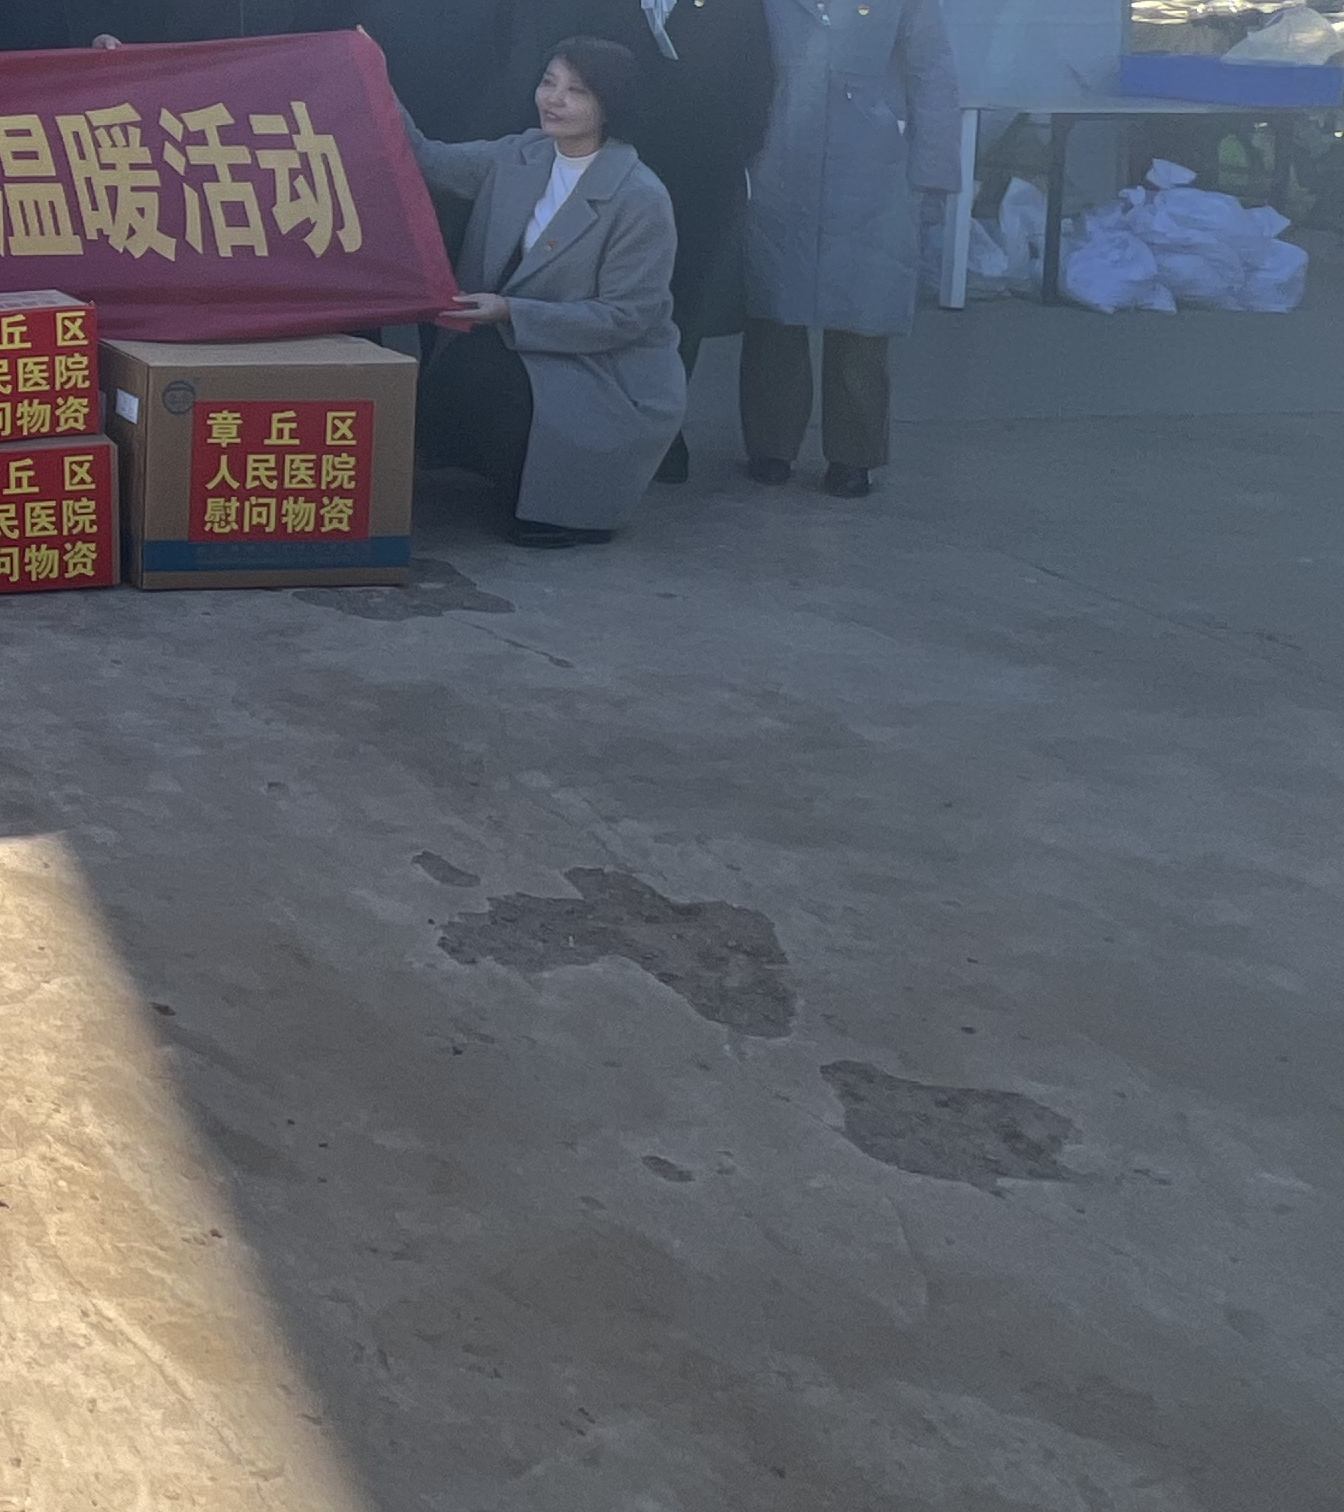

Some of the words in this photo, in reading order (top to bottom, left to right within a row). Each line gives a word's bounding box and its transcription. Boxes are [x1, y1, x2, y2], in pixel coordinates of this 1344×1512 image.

[206, 409, 358, 447] 章丘区
[205, 452, 356, 490] 人民医院
[204, 495, 354, 534] 慰问物资
